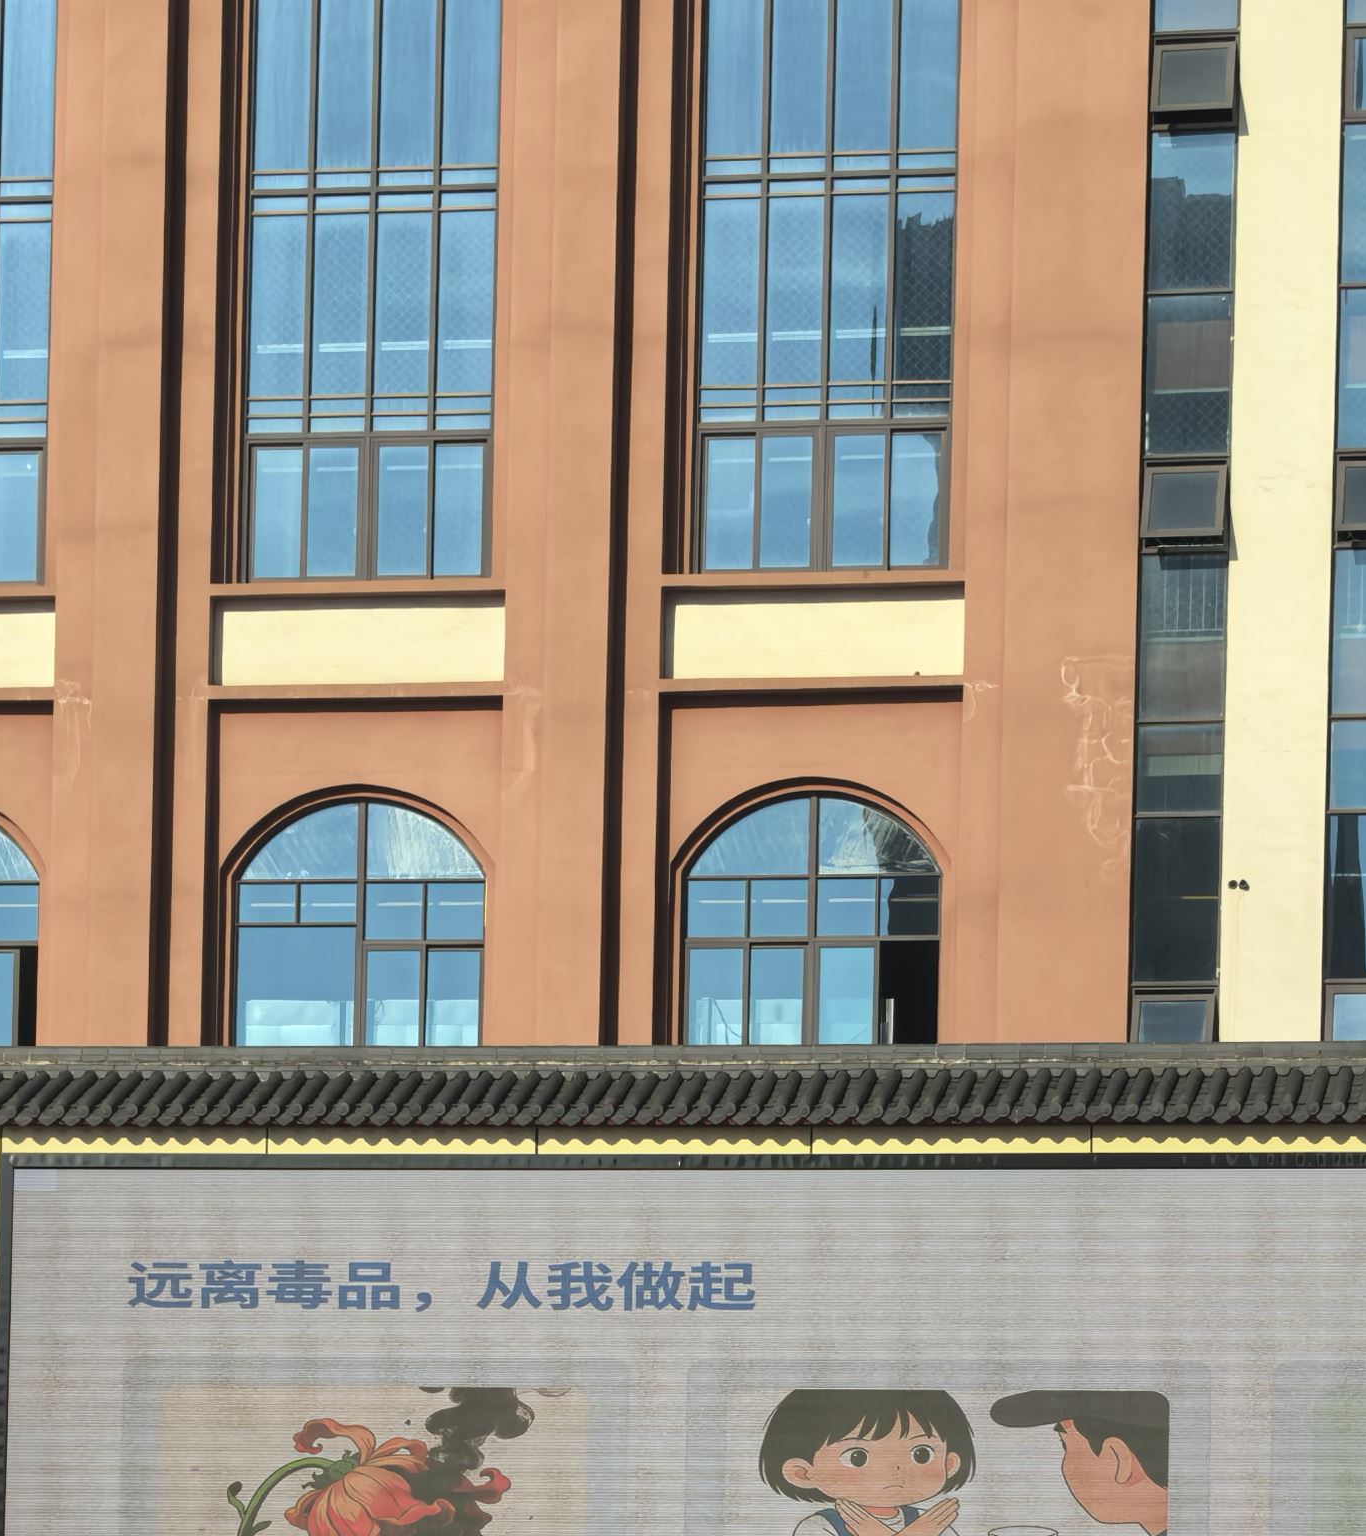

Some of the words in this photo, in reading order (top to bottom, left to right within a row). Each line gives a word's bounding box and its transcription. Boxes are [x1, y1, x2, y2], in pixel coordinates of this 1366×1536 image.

[128, 1259, 756, 1313] 远离毒品，从我做起
